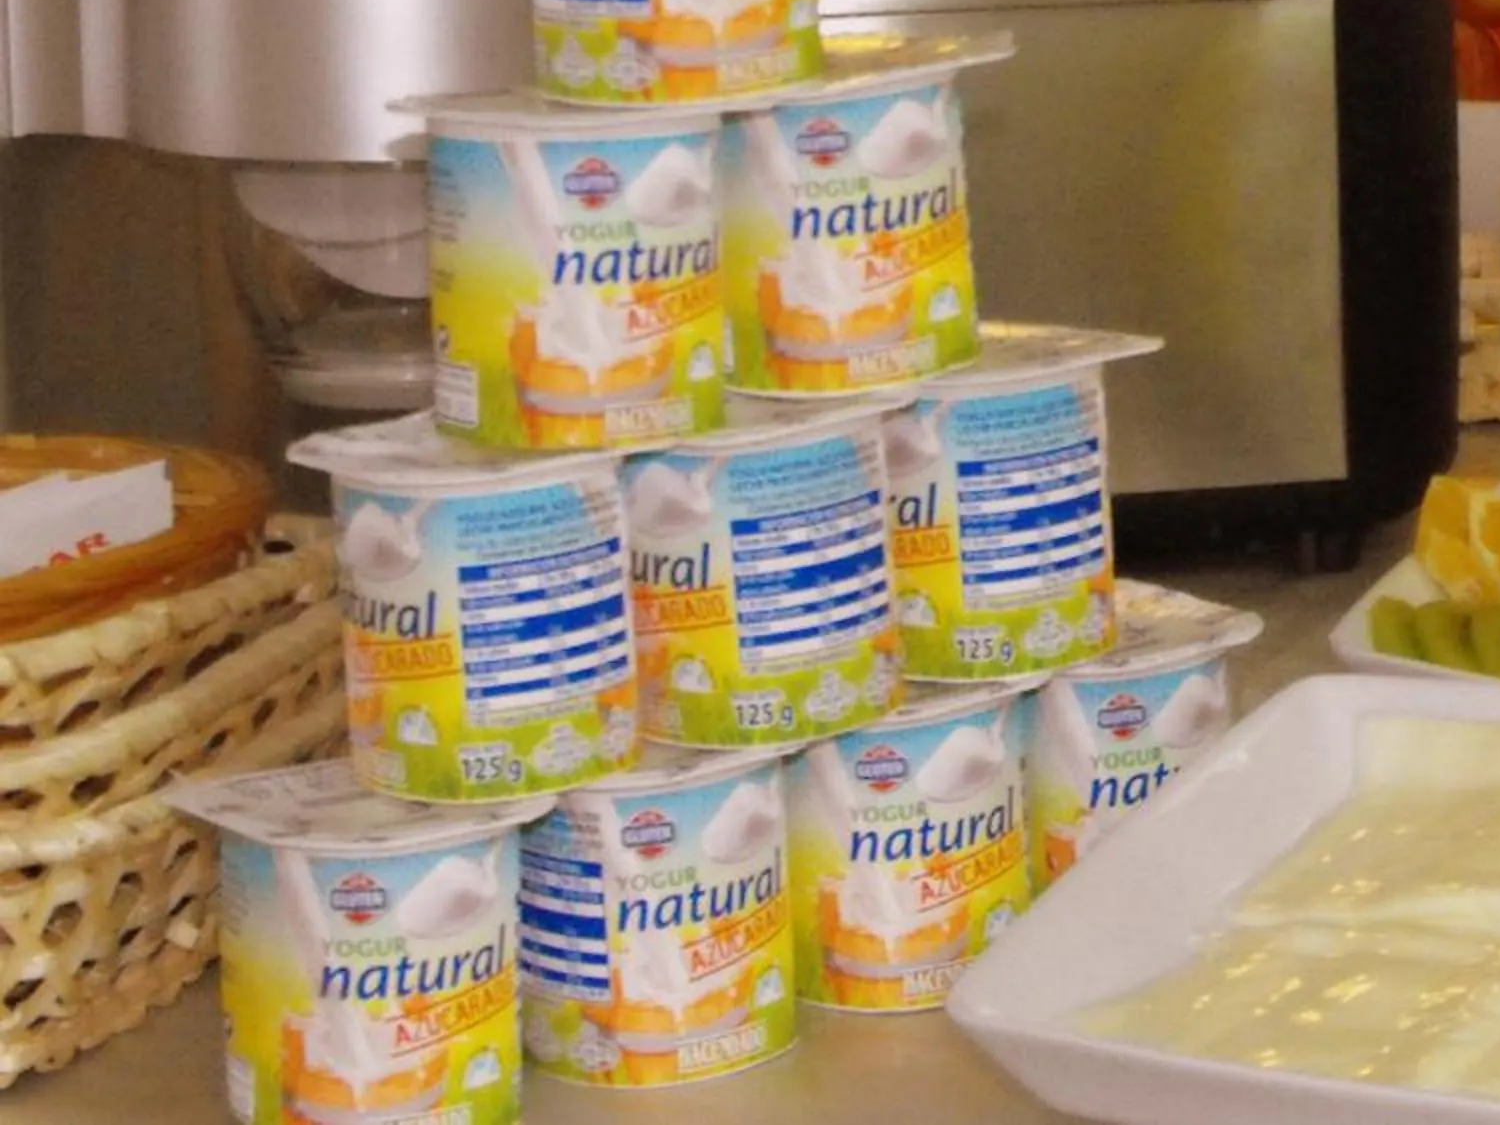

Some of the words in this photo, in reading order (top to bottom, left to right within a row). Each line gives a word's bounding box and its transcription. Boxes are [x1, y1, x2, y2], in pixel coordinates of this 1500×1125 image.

[791, 167, 958, 240] natural
[630, 542, 709, 591] ural
[352, 590, 437, 640] ural
[957, 639, 993, 661] 125
[999, 641, 1014, 663] g
[735, 704, 773, 726] 125
[780, 704, 794, 726] g
[461, 756, 501, 782] 125
[507, 758, 522, 783] g
[1090, 762, 1172, 809] nat
[850, 800, 927, 823] YOGUR
[850, 785, 1014, 862] natural
[615, 865, 697, 892] YOGUR
[618, 846, 781, 932] natural
[319, 923, 506, 1001] natural
[325, 936, 408, 958] YOGUR
